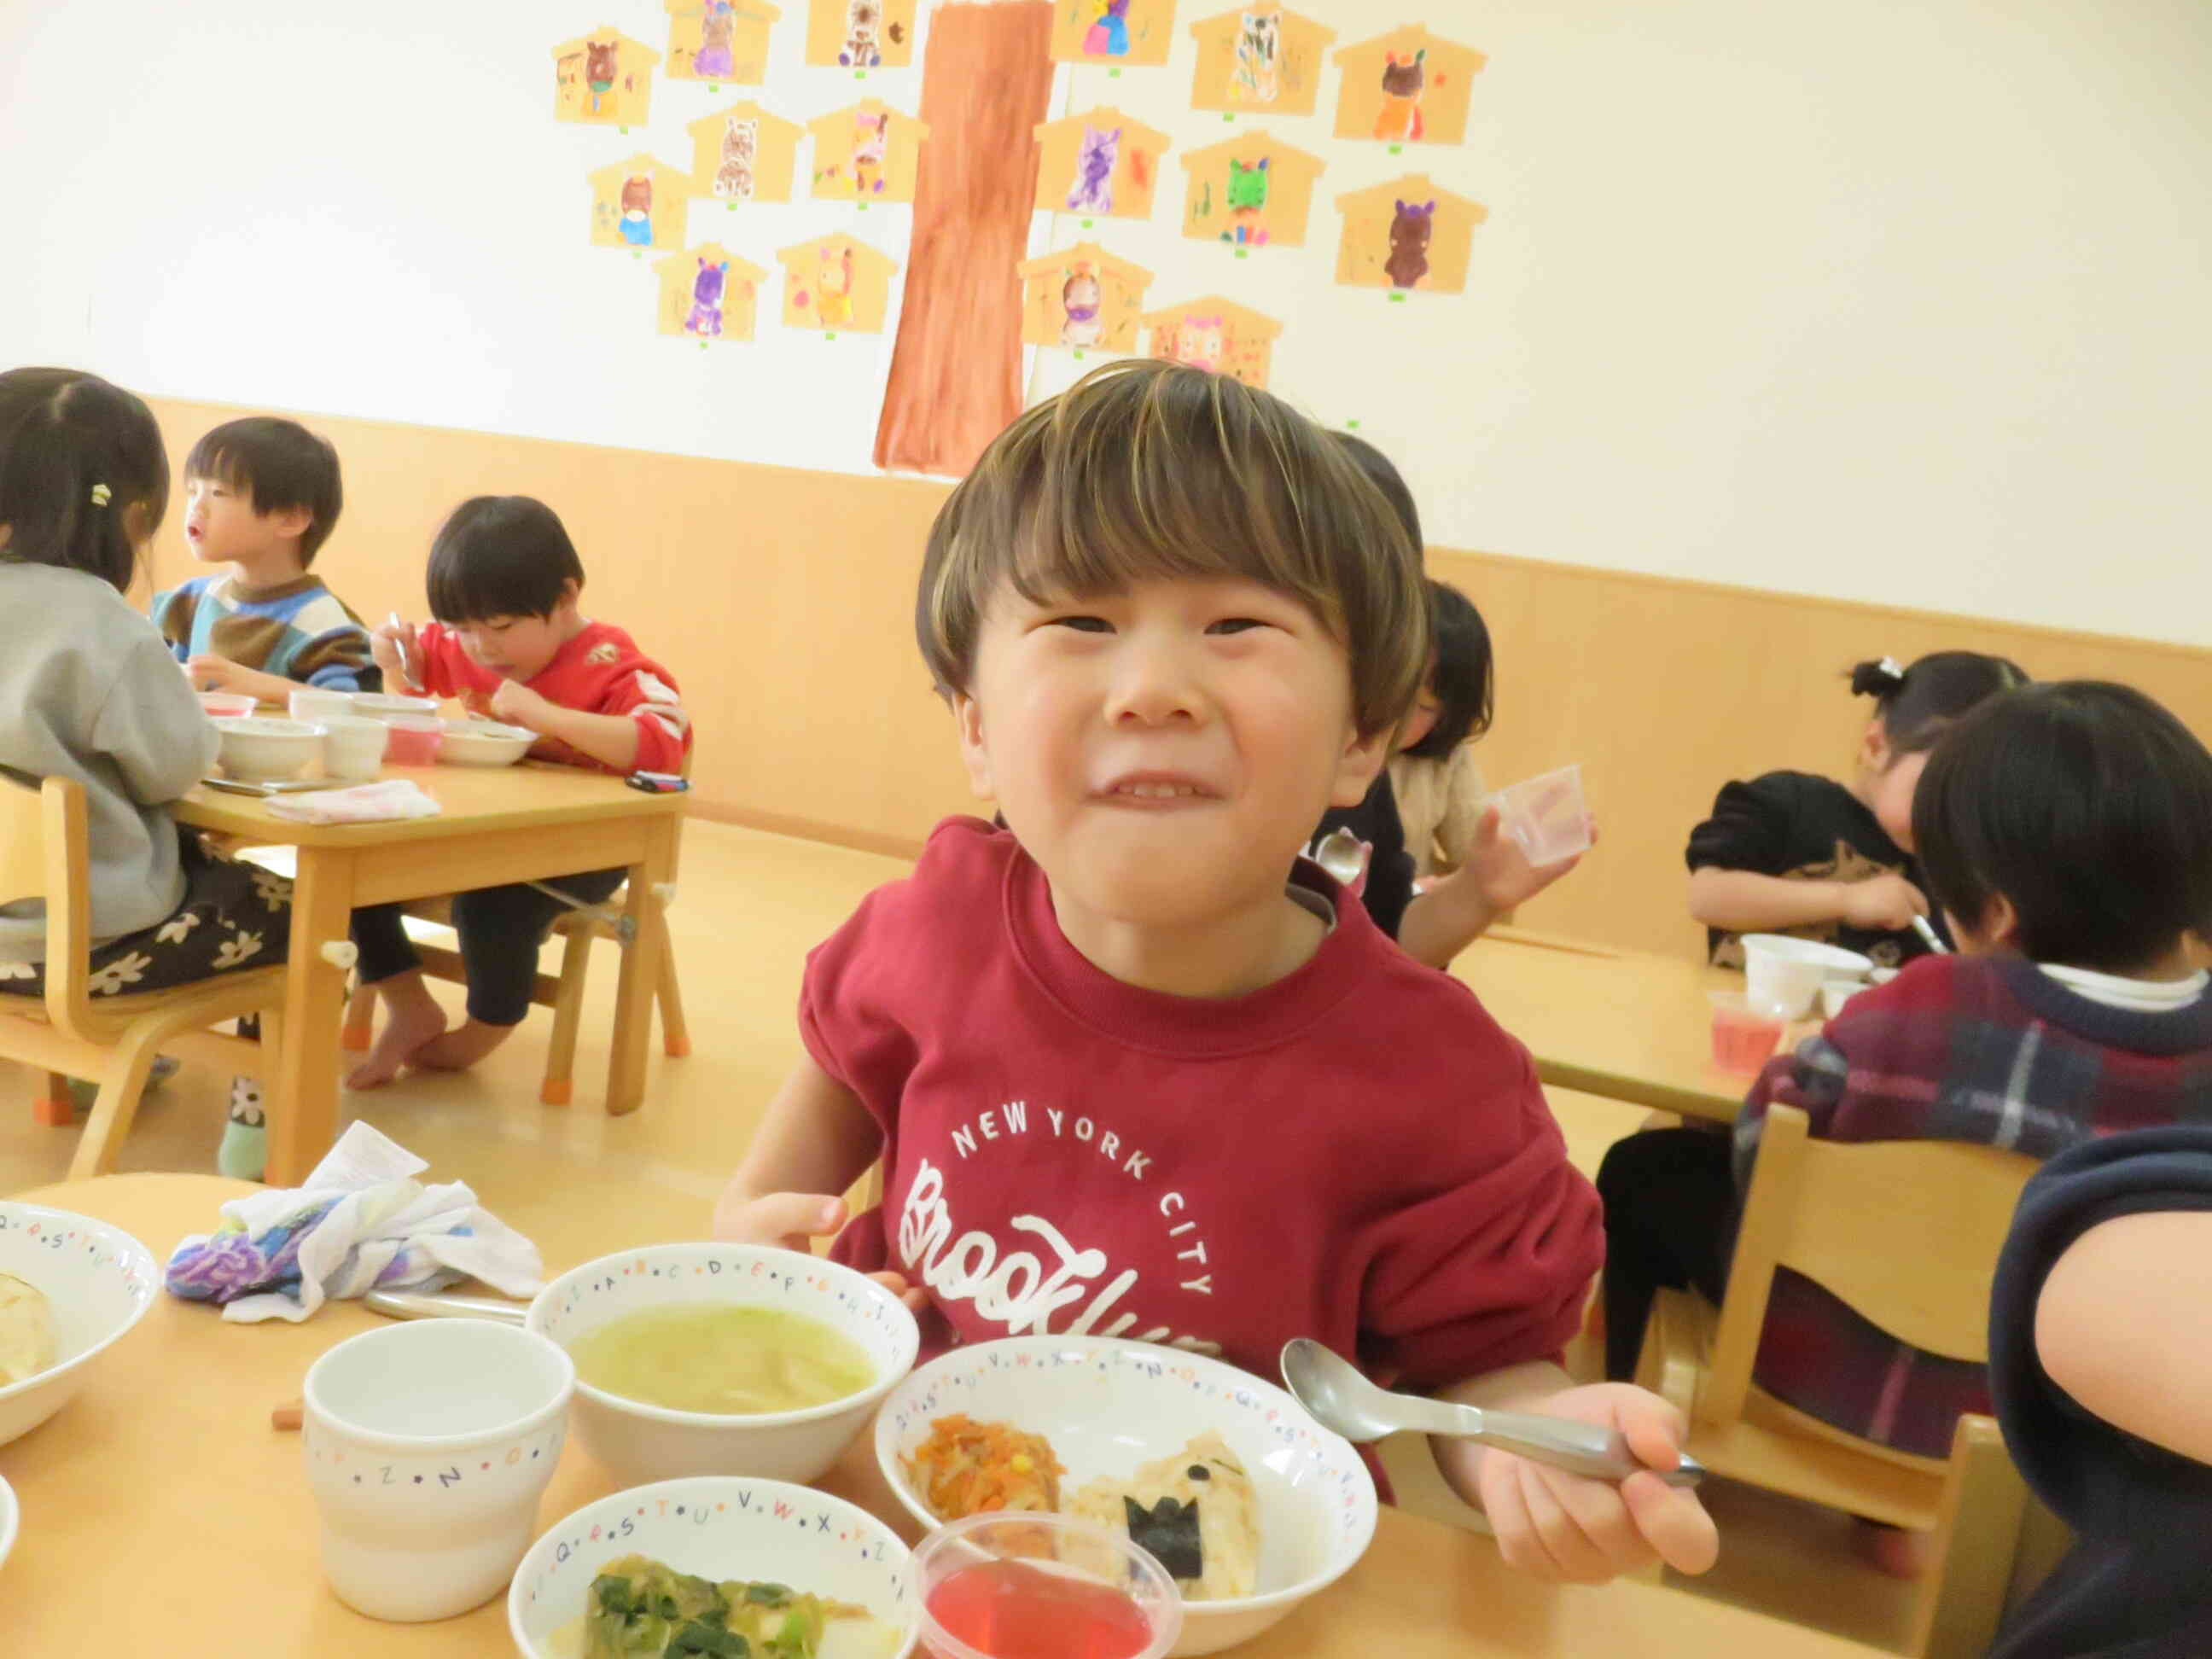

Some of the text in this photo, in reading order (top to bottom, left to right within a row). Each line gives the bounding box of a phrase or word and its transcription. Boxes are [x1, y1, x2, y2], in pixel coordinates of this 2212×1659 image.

[951, 1101, 1213, 1295] NEW YORK CITY
[707, 1260, 722, 1275] D
[438, 1465, 462, 1488] N
[556, 1541, 571, 1563] Q
[620, 1516, 635, 1537] S
[655, 1499, 670, 1516] T
[693, 1507, 709, 1525] U
[737, 1490, 752, 1509] V
[773, 1498, 794, 1521] W
[817, 1514, 831, 1533] X
